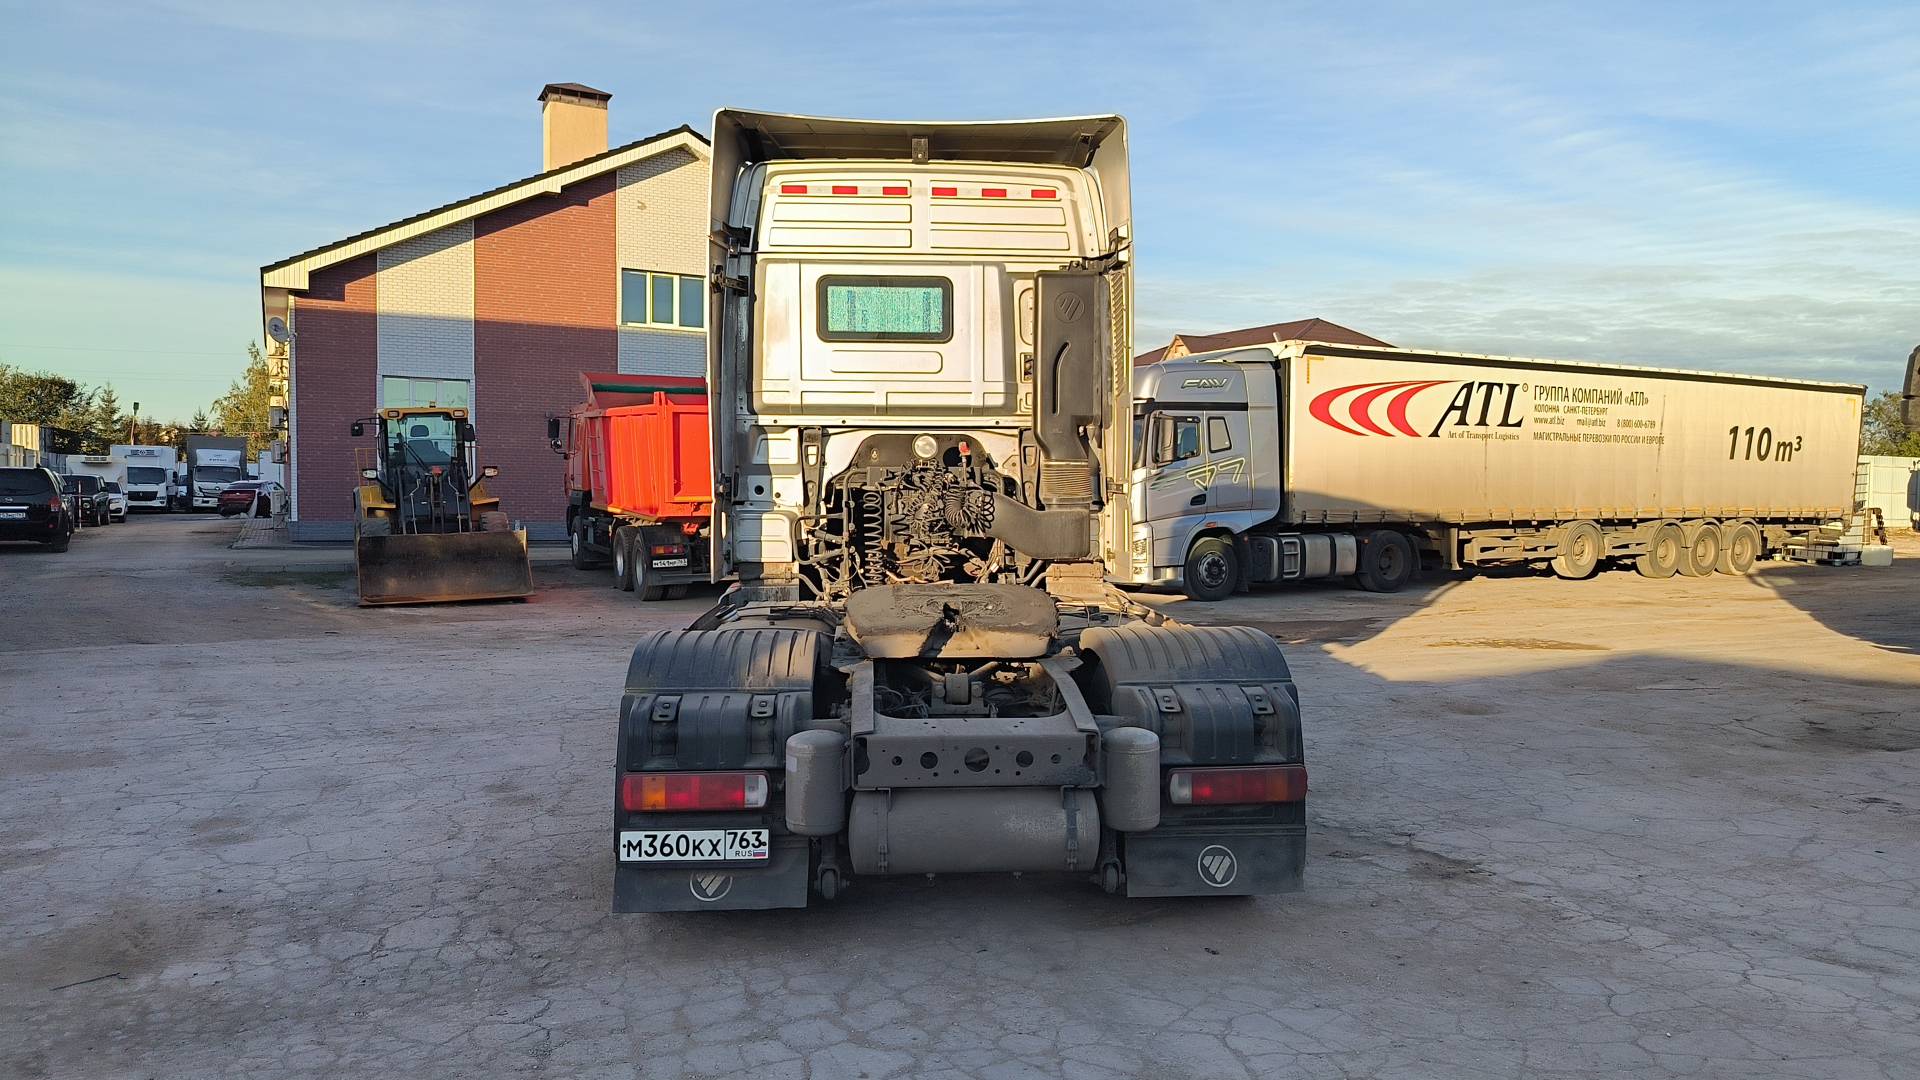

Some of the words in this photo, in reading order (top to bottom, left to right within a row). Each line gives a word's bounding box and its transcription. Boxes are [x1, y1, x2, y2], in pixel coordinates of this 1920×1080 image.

[1181, 379, 1227, 389] FAW
[1534, 385, 1569, 402] ГРУППА
[1572, 388, 1623, 405] КОМПАНИЙ
[1625, 391, 1649, 406] «АТЛ»
[1428, 381, 1524, 437] ATL
[1534, 404, 1560, 413] КОЛОННА
[1563, 405, 1608, 416] САНКТ-ПЕТЕРБУРГ
[1448, 431, 1457, 439] Art
[1458, 431, 1465, 439] of
[1466, 431, 1494, 441] Transport
[1495, 432, 1520, 441] Logistics
[1533, 431, 1581, 442] МАГИСТРАЛЬНЫЕ
[1582, 433, 1612, 443] ПЕРЕВОЗКИ
[1612, 434, 1621, 443] ПО
[1621, 435, 1641, 444] РОССИИ
[1647, 435, 1665, 445] ЕВРОПЕ
[1729, 426, 1772, 461] 110
[727, 831, 763, 849] 763
